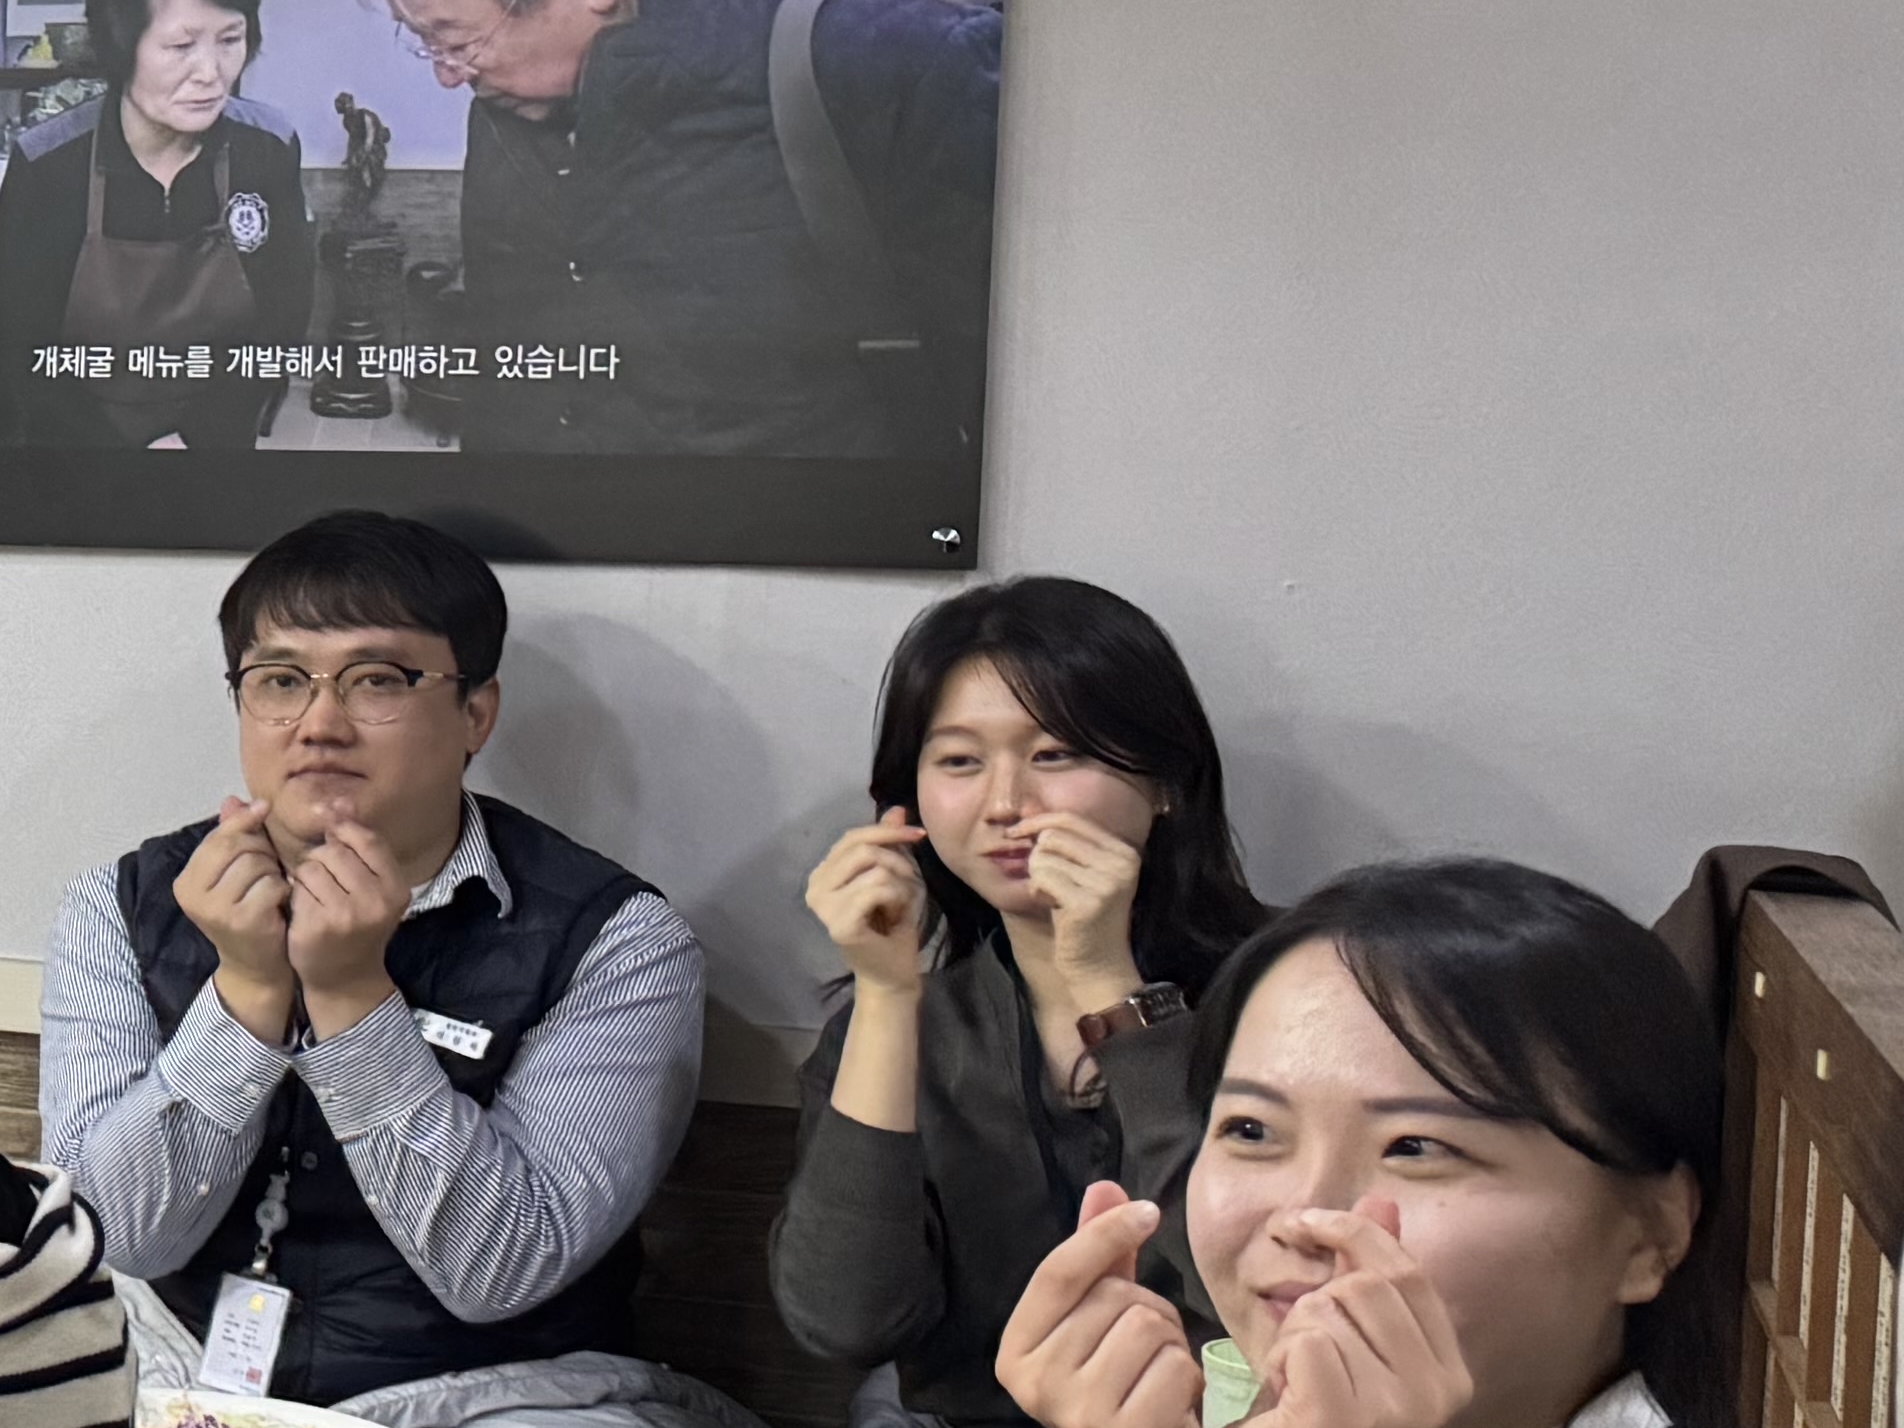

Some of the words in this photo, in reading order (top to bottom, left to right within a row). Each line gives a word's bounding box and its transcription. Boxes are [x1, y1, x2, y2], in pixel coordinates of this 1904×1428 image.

[31, 345, 115, 379] 개체굴
[128, 345, 214, 379] 메뉴를
[226, 345, 343, 379] 개발해서
[357, 344, 480, 379] 판매하고
[494, 344, 620, 380] 있습니다
